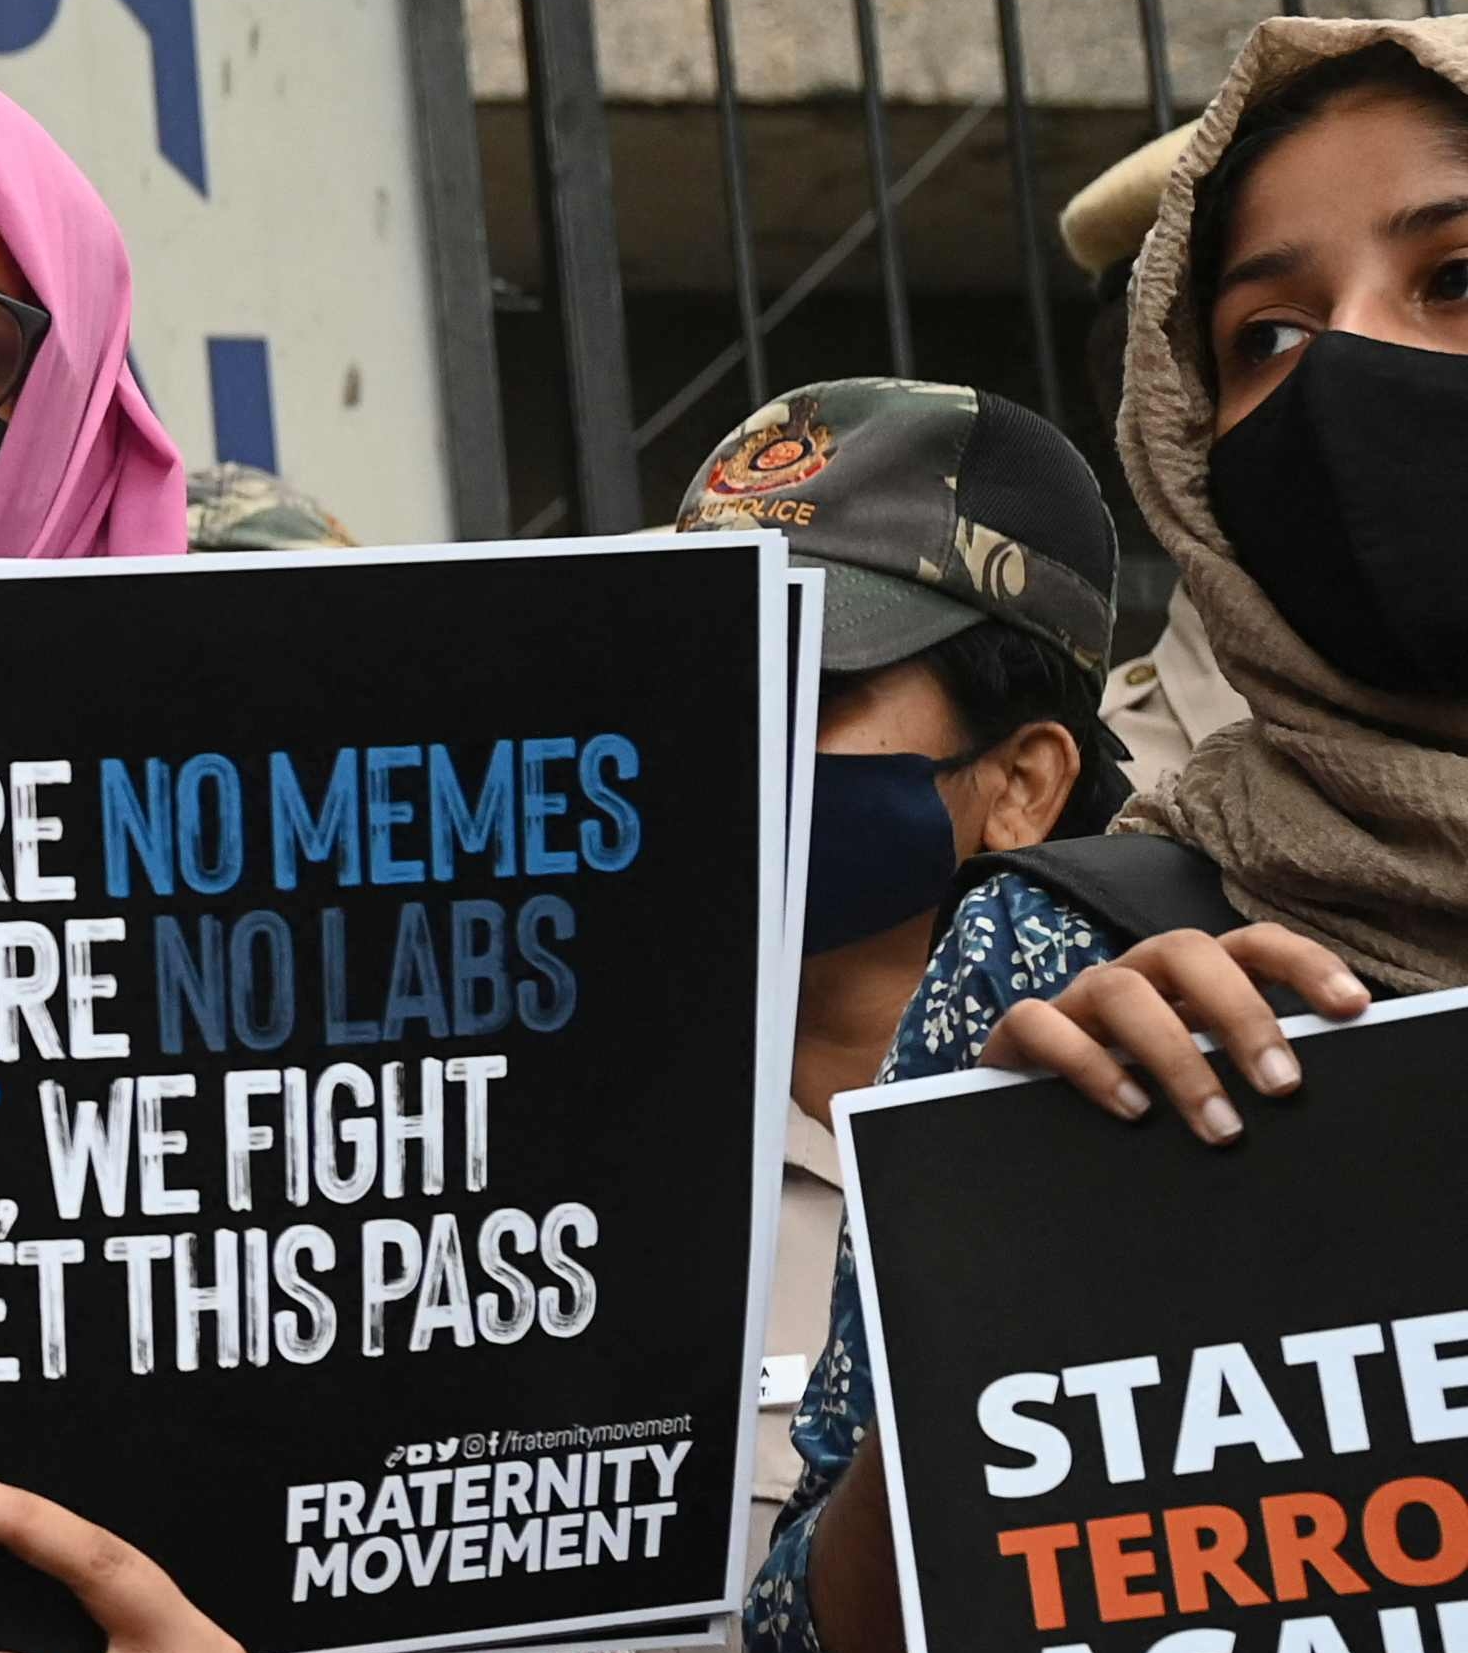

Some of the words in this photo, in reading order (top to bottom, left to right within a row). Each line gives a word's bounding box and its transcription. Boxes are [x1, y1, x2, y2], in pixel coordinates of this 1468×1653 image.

[100, 752, 243, 899] NO
[269, 733, 641, 891] MEMES
[153, 908, 295, 1055] NO
[320, 894, 577, 1046] LABS
[38, 1073, 200, 1220] WE
[224, 1054, 507, 1213] FIGHT
[105, 1224, 336, 1375] THIS
[361, 1201, 598, 1358] PASS
[977, 1310, 1468, 1499] STATE
[286, 1440, 693, 1543] FRATERNITY
[292, 1502, 678, 1603] MOVEMENT
